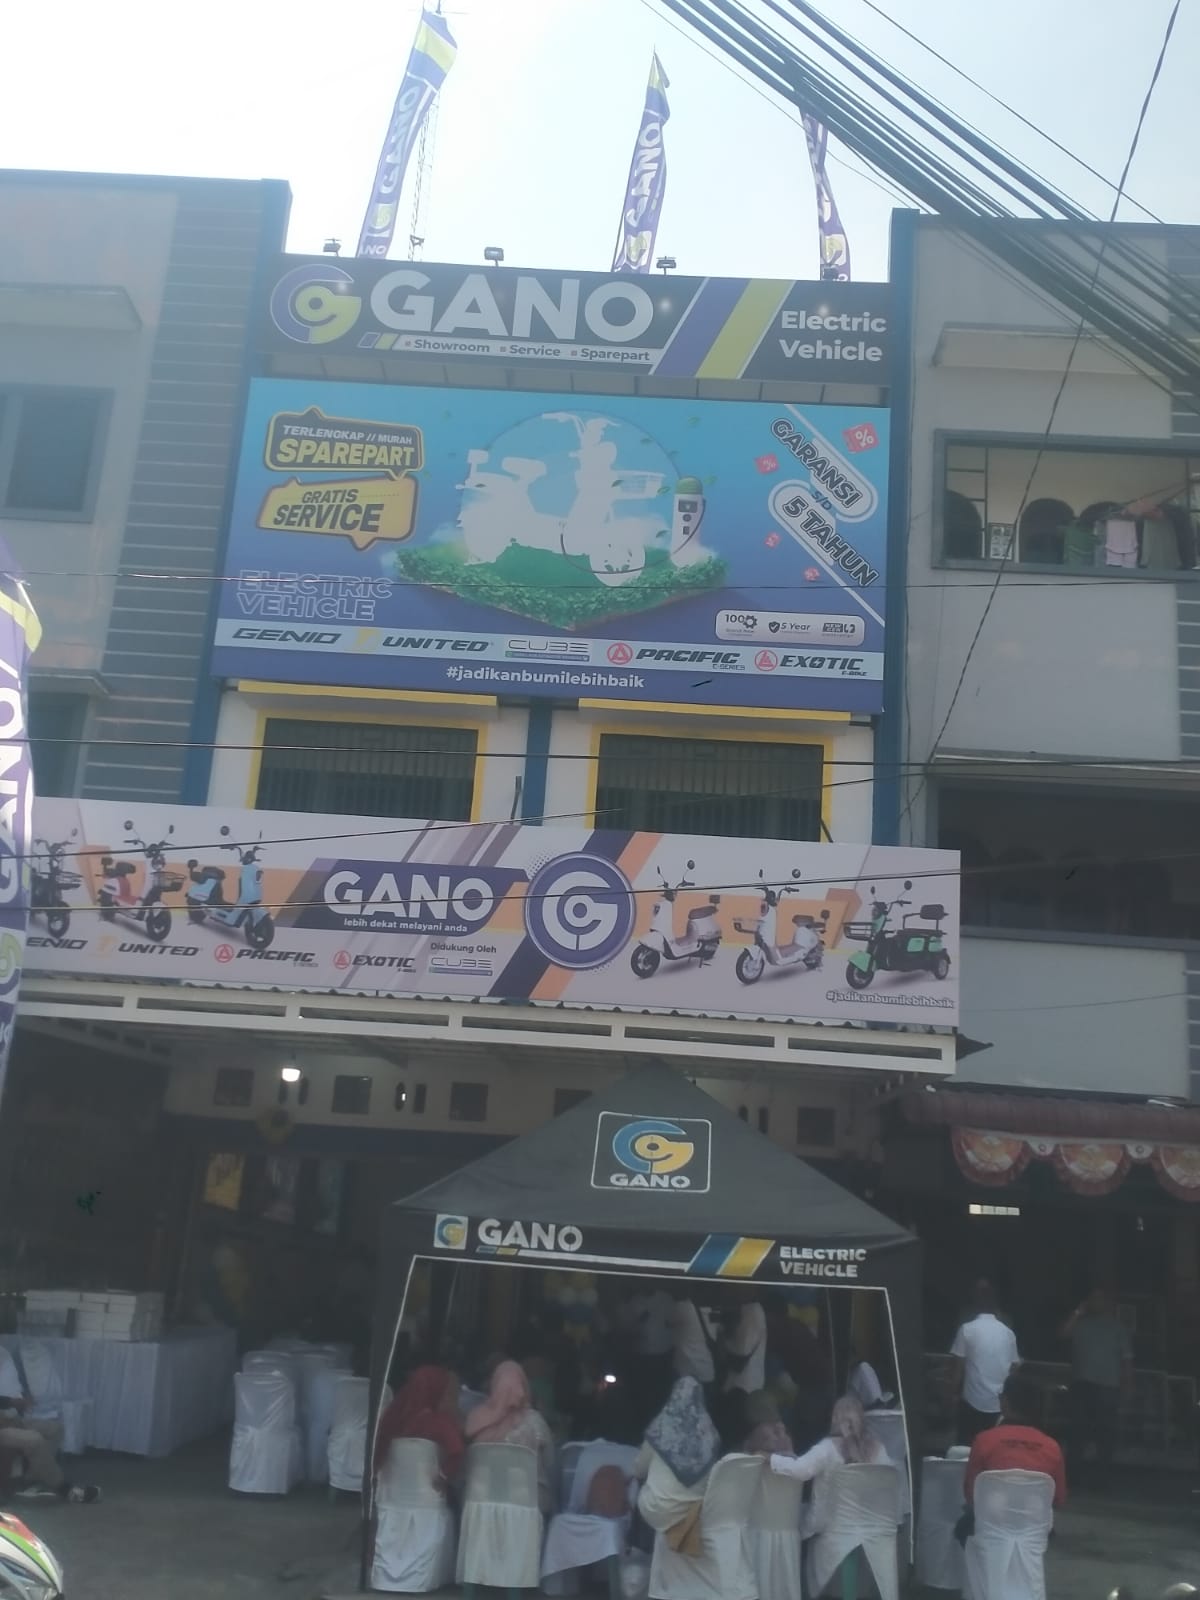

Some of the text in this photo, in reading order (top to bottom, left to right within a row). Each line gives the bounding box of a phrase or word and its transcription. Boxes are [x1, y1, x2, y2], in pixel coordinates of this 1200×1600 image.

[370, 269, 653, 342] GANO
[781, 310, 887, 333] Electric
[413, 338, 650, 362] Showroom Service Sparepart
[779, 339, 883, 362] Vehicle
[283, 425, 365, 441] TERLENGKAP
[378, 434, 413, 445] MURAH
[276, 438, 415, 466] SPAREPART
[772, 418, 863, 508] GARANSI
[302, 488, 359, 504] GRATIS
[273, 503, 384, 533] SERVICE
[782, 496, 879, 587] 5 TAHUN
[237, 569, 394, 599] ELECTRIC
[236, 592, 376, 622] VEHICLE
[781, 622, 812, 631] 5 Year
[232, 627, 864, 671] GENIO UNITED CUBE PACIFIC EXOTIC
[446, 665, 645, 688] #jadikanbumilebihbaik
[324, 870, 494, 922] GANO
[343, 918, 468, 934] lebih dekat melayani anda
[26, 937, 89, 950] ENIO
[118, 943, 200, 957] UNITED
[236, 948, 316, 963] PACIFIC
[352, 954, 416, 968] EXOTIC
[430, 942, 497, 954] Didukung Oleh
[826, 991, 955, 1009] #jadikanbumilebihbaik
[609, 1173, 691, 1188] GANO
[477, 1218, 583, 1252] GANO
[779, 1246, 867, 1261] ELECTRIC
[779, 1261, 858, 1277] VEHICLE
